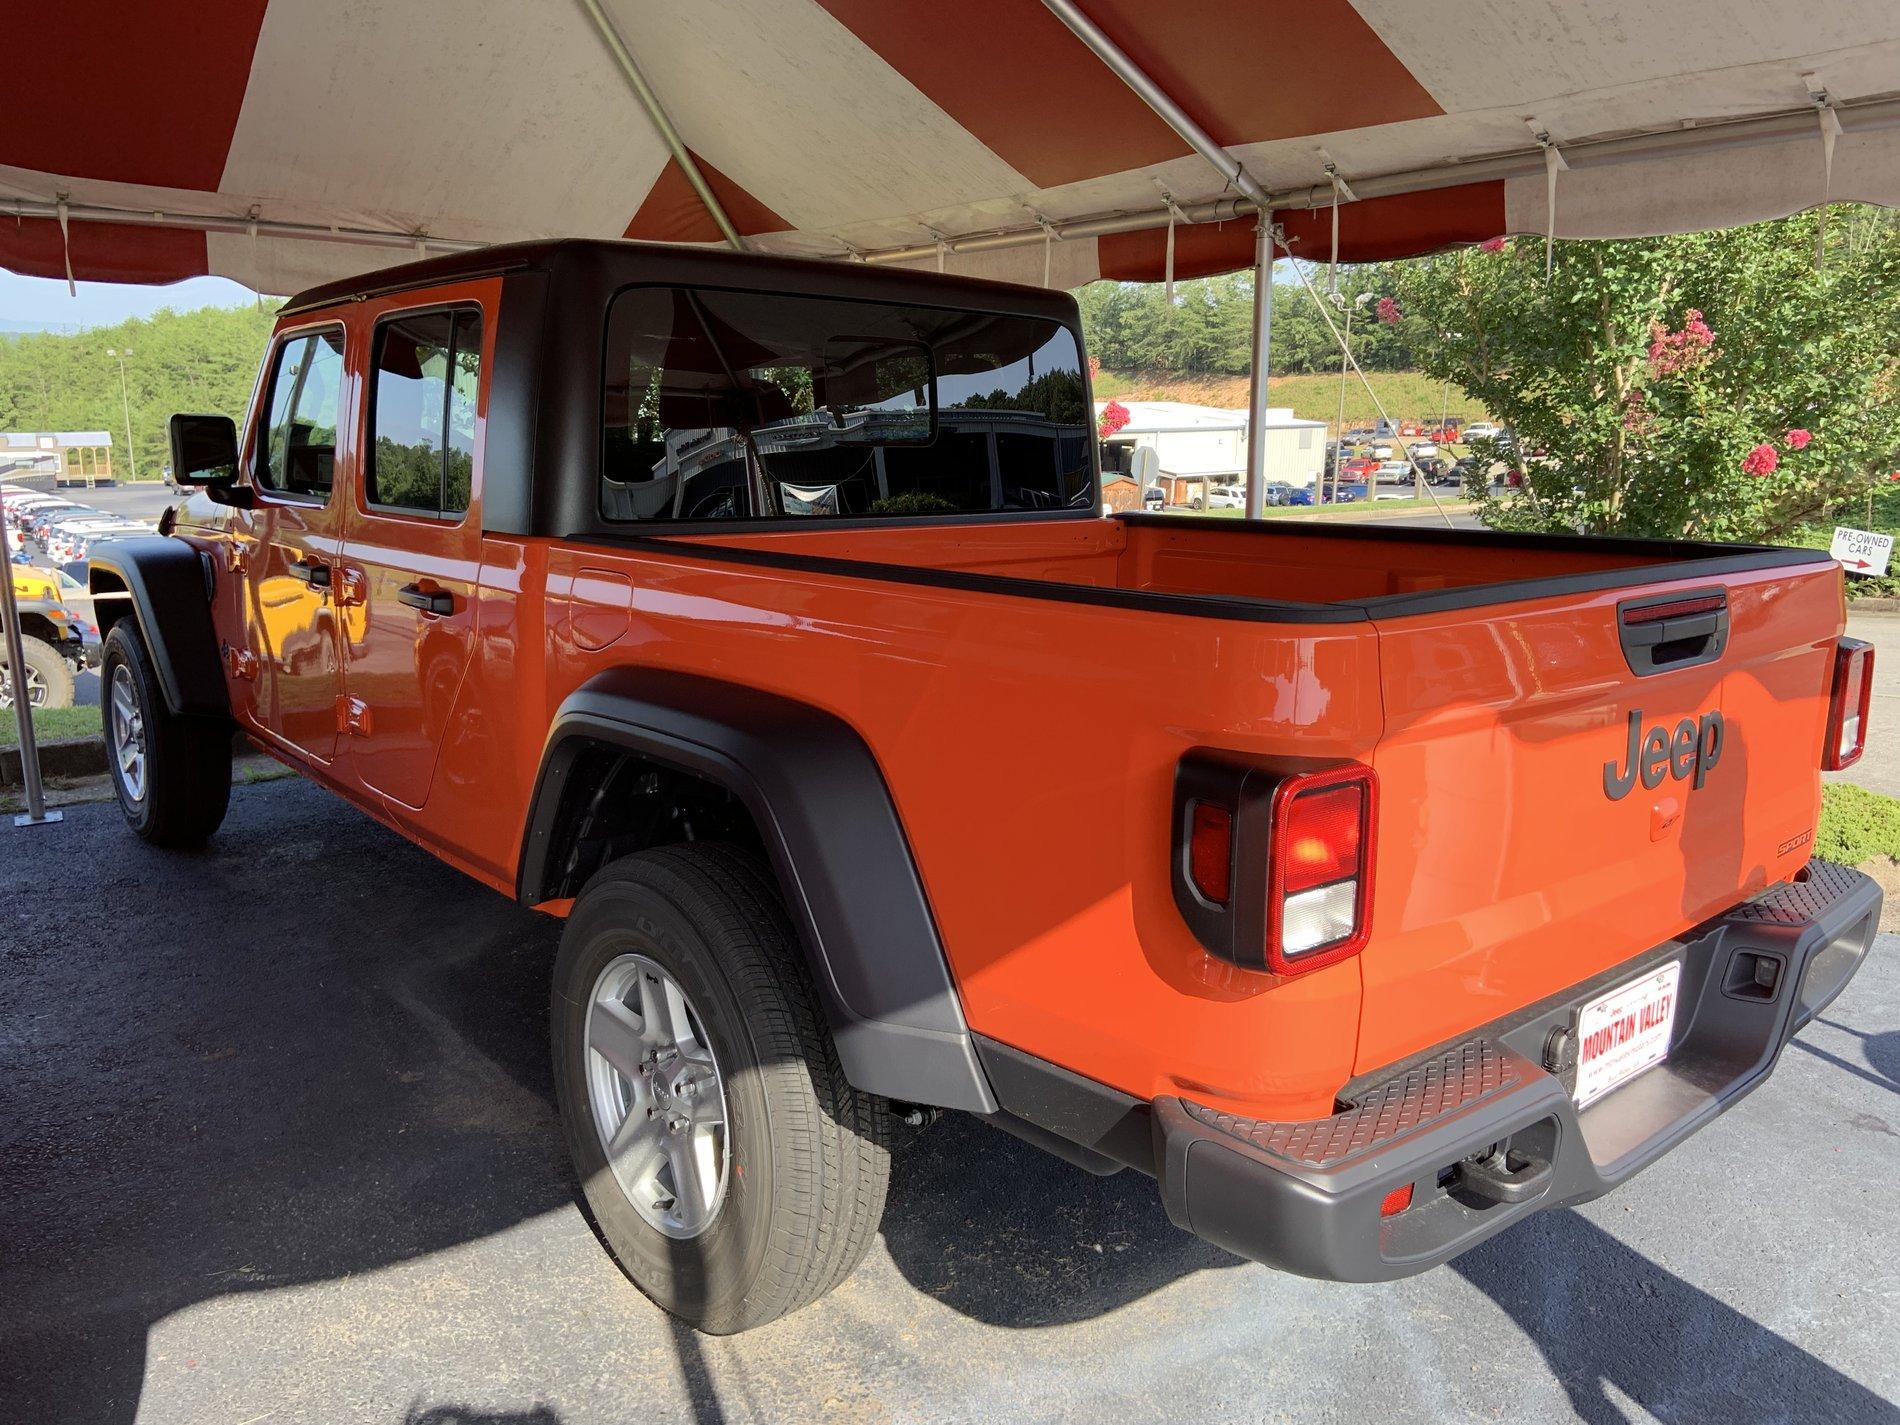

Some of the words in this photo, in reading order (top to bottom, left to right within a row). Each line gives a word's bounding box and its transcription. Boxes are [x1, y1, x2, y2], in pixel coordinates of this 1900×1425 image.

[1837, 530, 1889, 548] PRE-OWNED
[1848, 543, 1873, 556] CARS
[1603, 709, 1724, 801] Jeep
[1777, 830, 1812, 856] SPORT
[1582, 1011, 1636, 1065] MOUNTAIN
[1639, 993, 1673, 1034] VALLEY
